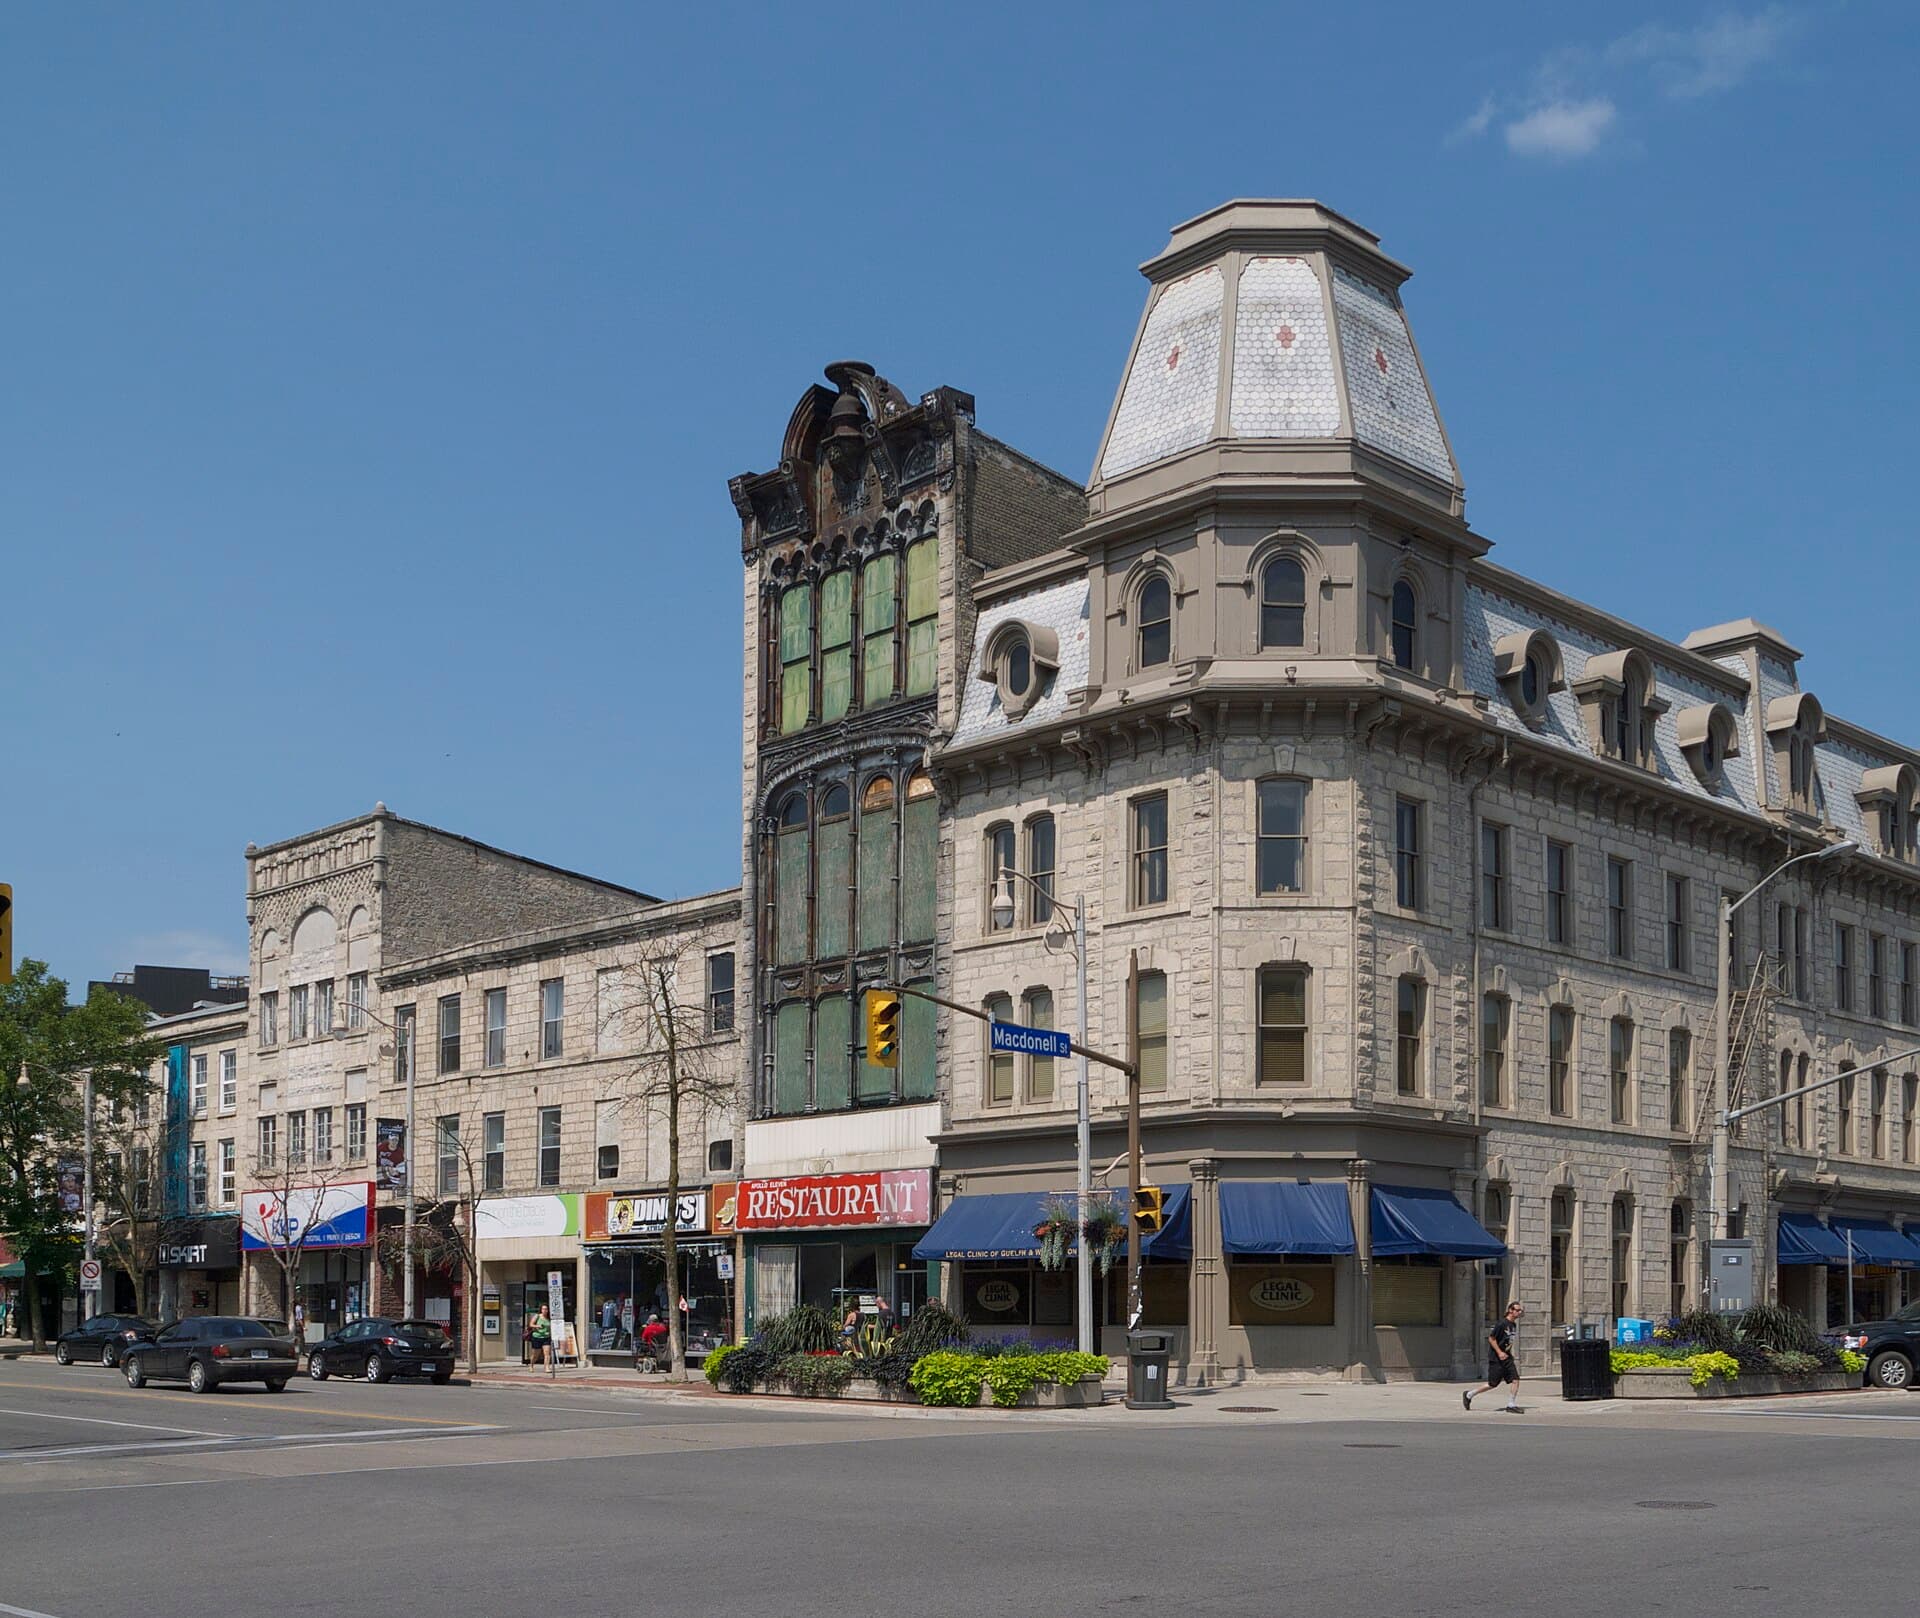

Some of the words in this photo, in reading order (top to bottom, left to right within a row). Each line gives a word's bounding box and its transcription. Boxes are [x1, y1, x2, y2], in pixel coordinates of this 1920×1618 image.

[994, 1027, 1057, 1053] Macdonell
[1060, 1042, 1068, 1054] St
[745, 1180, 918, 1221] RESTAURANT
[170, 1244, 208, 1264] SKIRT
[945, 1250, 965, 1258] LEGAL
[967, 1250, 989, 1258] CLINIC
[990, 1250, 999, 1258] OF
[1001, 1249, 1027, 1257] GUELPH
[1262, 1281, 1301, 1291] LEGAL
[984, 1293, 1012, 1302] CLINIC
[1260, 1291, 1303, 1301] CLINIC
